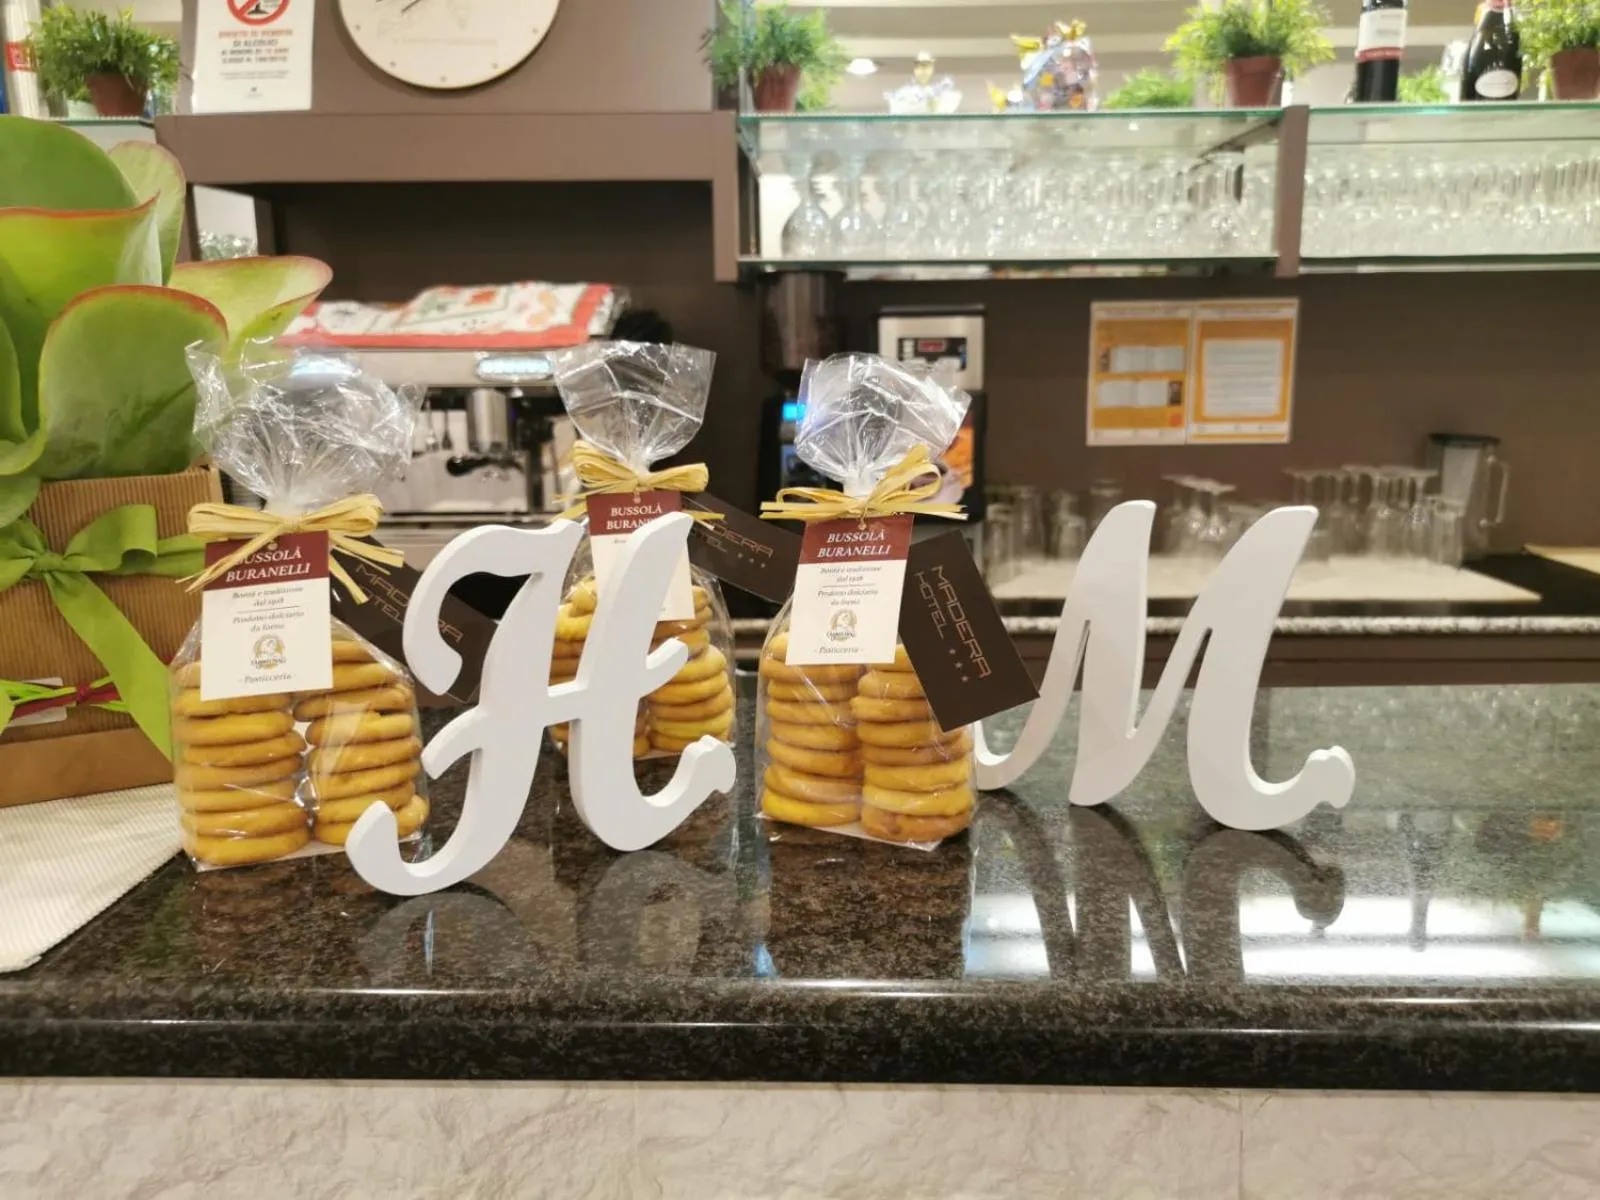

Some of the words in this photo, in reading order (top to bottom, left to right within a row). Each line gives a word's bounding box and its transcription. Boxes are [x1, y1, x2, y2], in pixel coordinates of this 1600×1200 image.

[226, 562, 311, 582] BURANELLI
[817, 544, 892, 557] BURANELLI
[914, 571, 947, 639] HOTEL
[932, 564, 992, 679] MADERA
[245, 673, 292, 684] Pasticceria
[345, 511, 737, 896] H
[973, 499, 1356, 831] M
